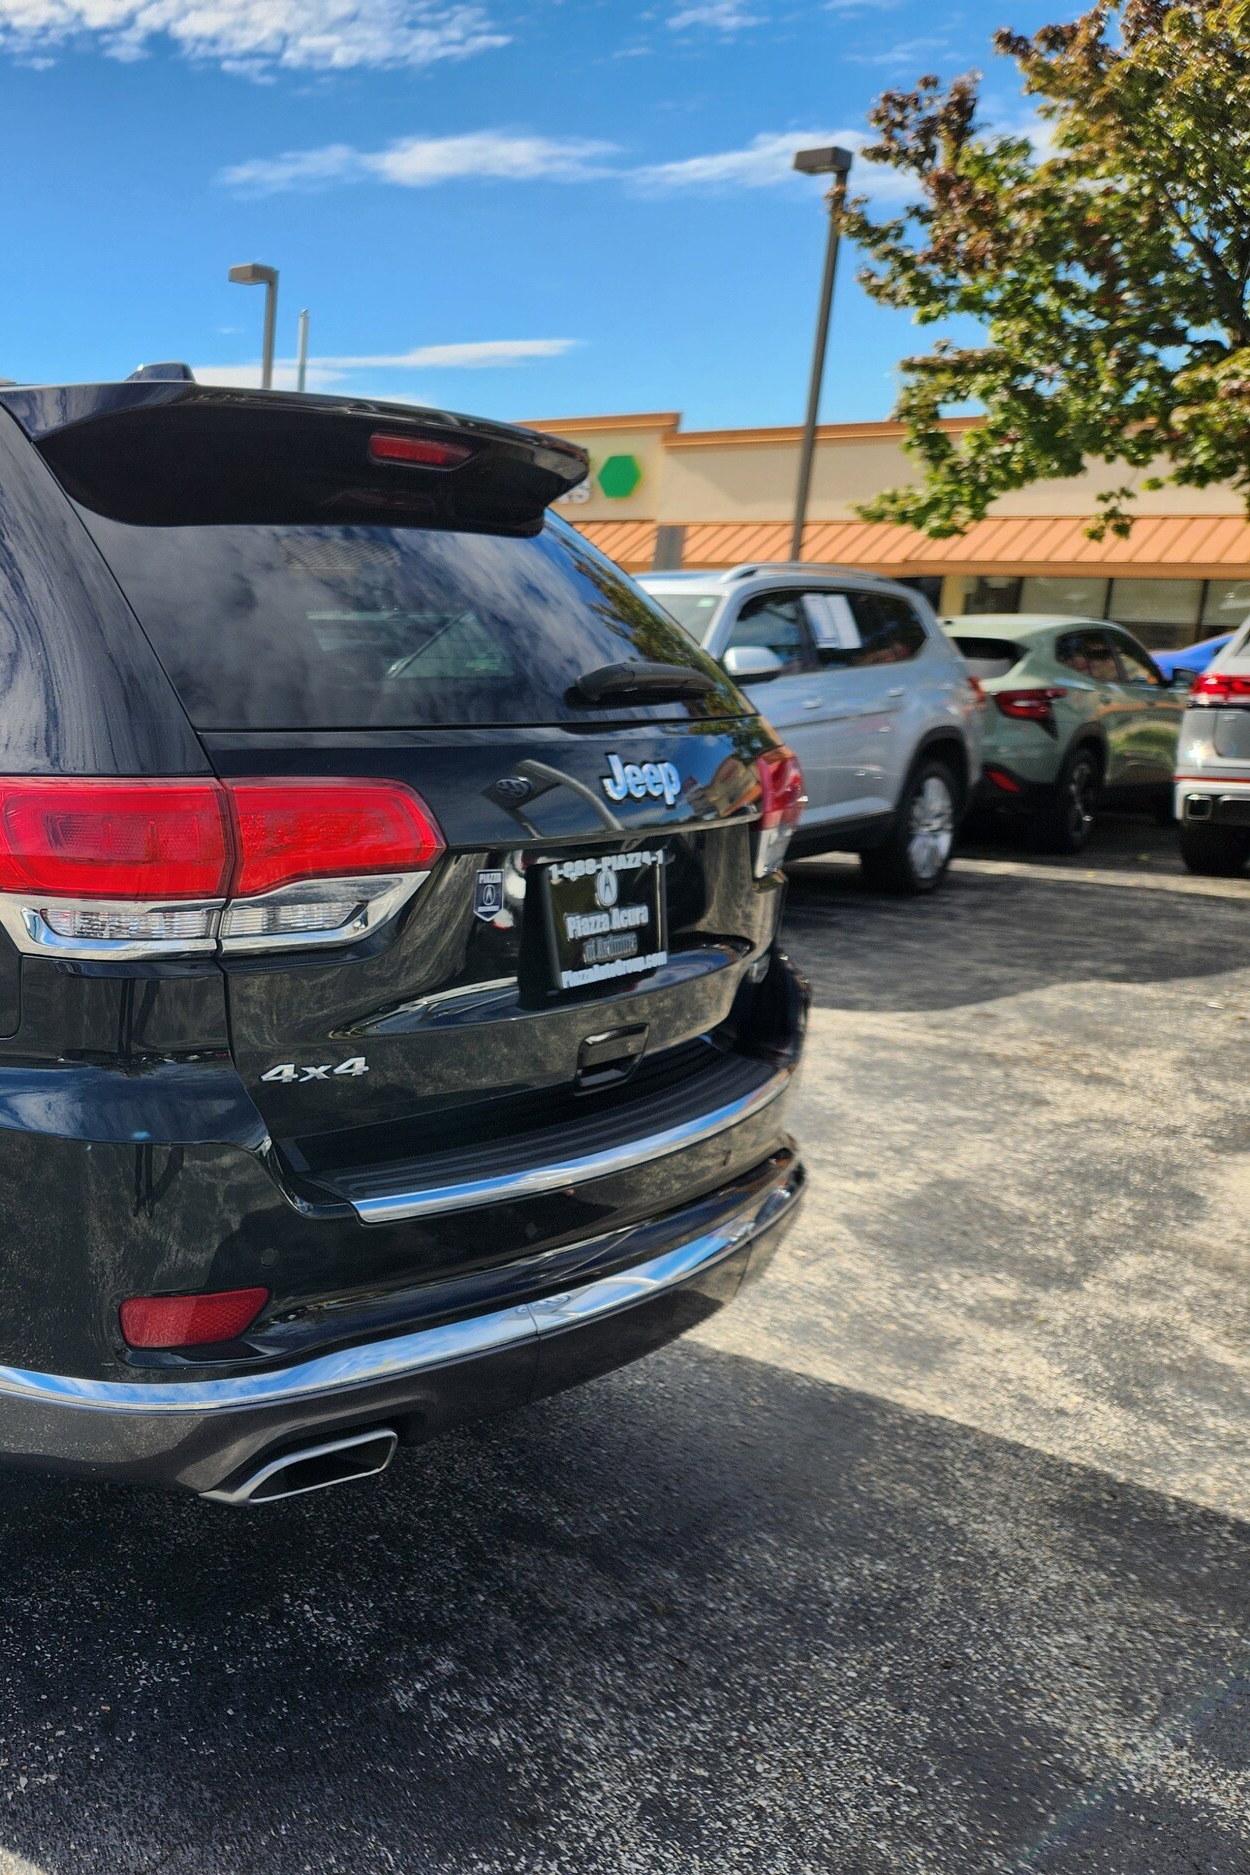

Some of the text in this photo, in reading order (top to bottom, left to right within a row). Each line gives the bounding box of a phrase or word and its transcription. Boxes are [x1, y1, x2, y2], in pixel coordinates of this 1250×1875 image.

[602, 753, 682, 806] Jeep
[565, 904, 649, 941] Piazza Acura
[260, 1056, 370, 1083] 4x4
